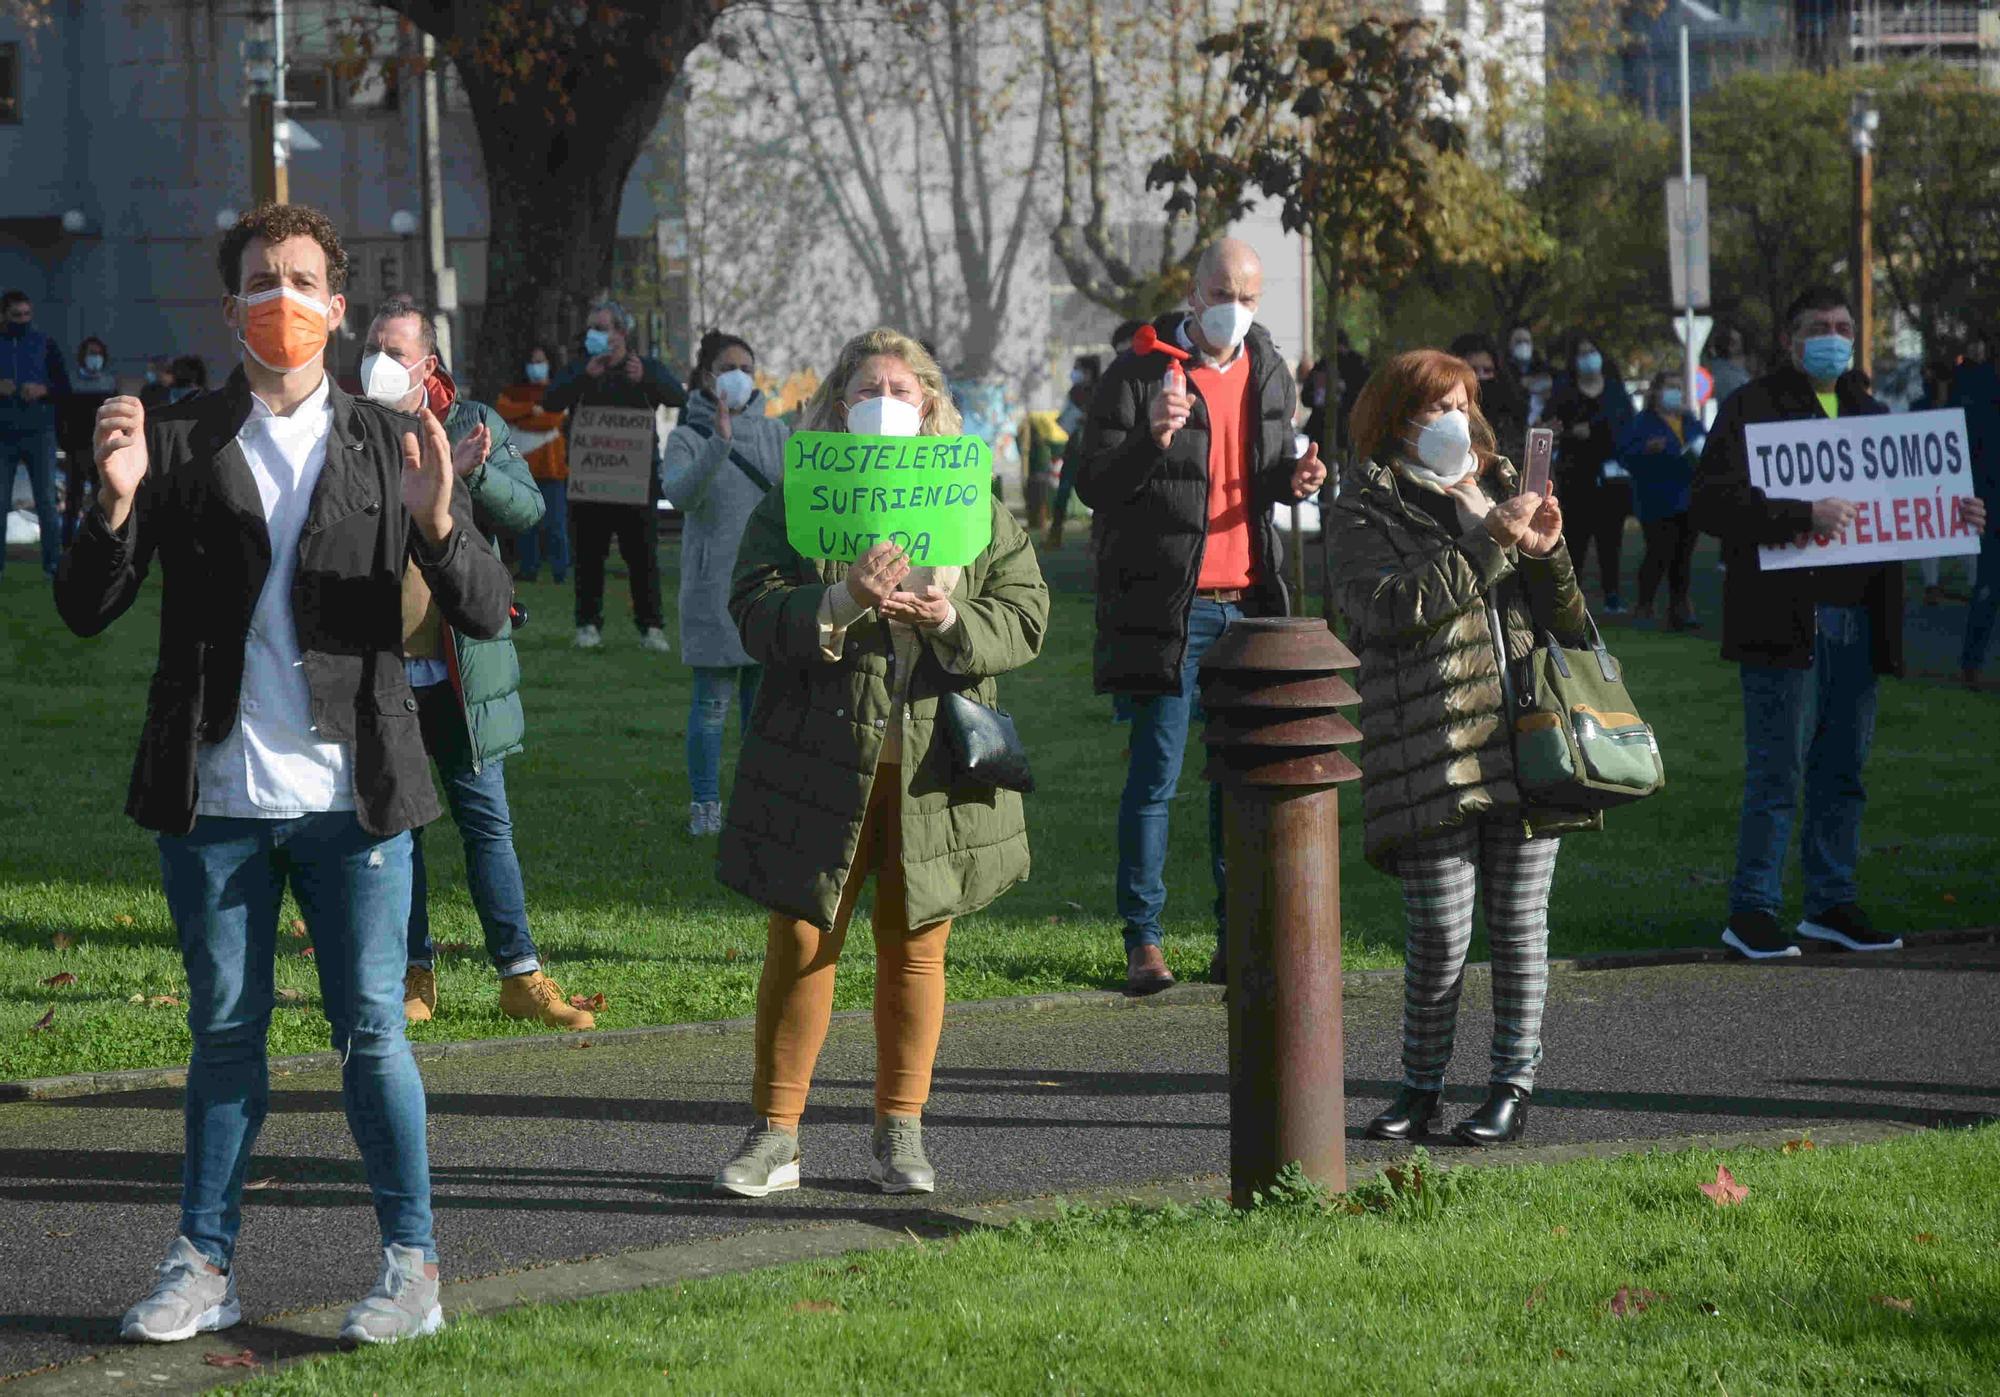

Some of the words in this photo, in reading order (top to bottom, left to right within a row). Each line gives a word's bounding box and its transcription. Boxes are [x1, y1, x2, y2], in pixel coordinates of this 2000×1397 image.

[581, 450, 629, 469] AYUDA
[795, 436, 979, 474] HOSTELERÍA
[1756, 438, 1855, 488] TODOS
[1861, 431, 1962, 480] SOMOS
[810, 483, 978, 515] SUFRIENDO
[1766, 485, 1971, 550] ELERÍA
